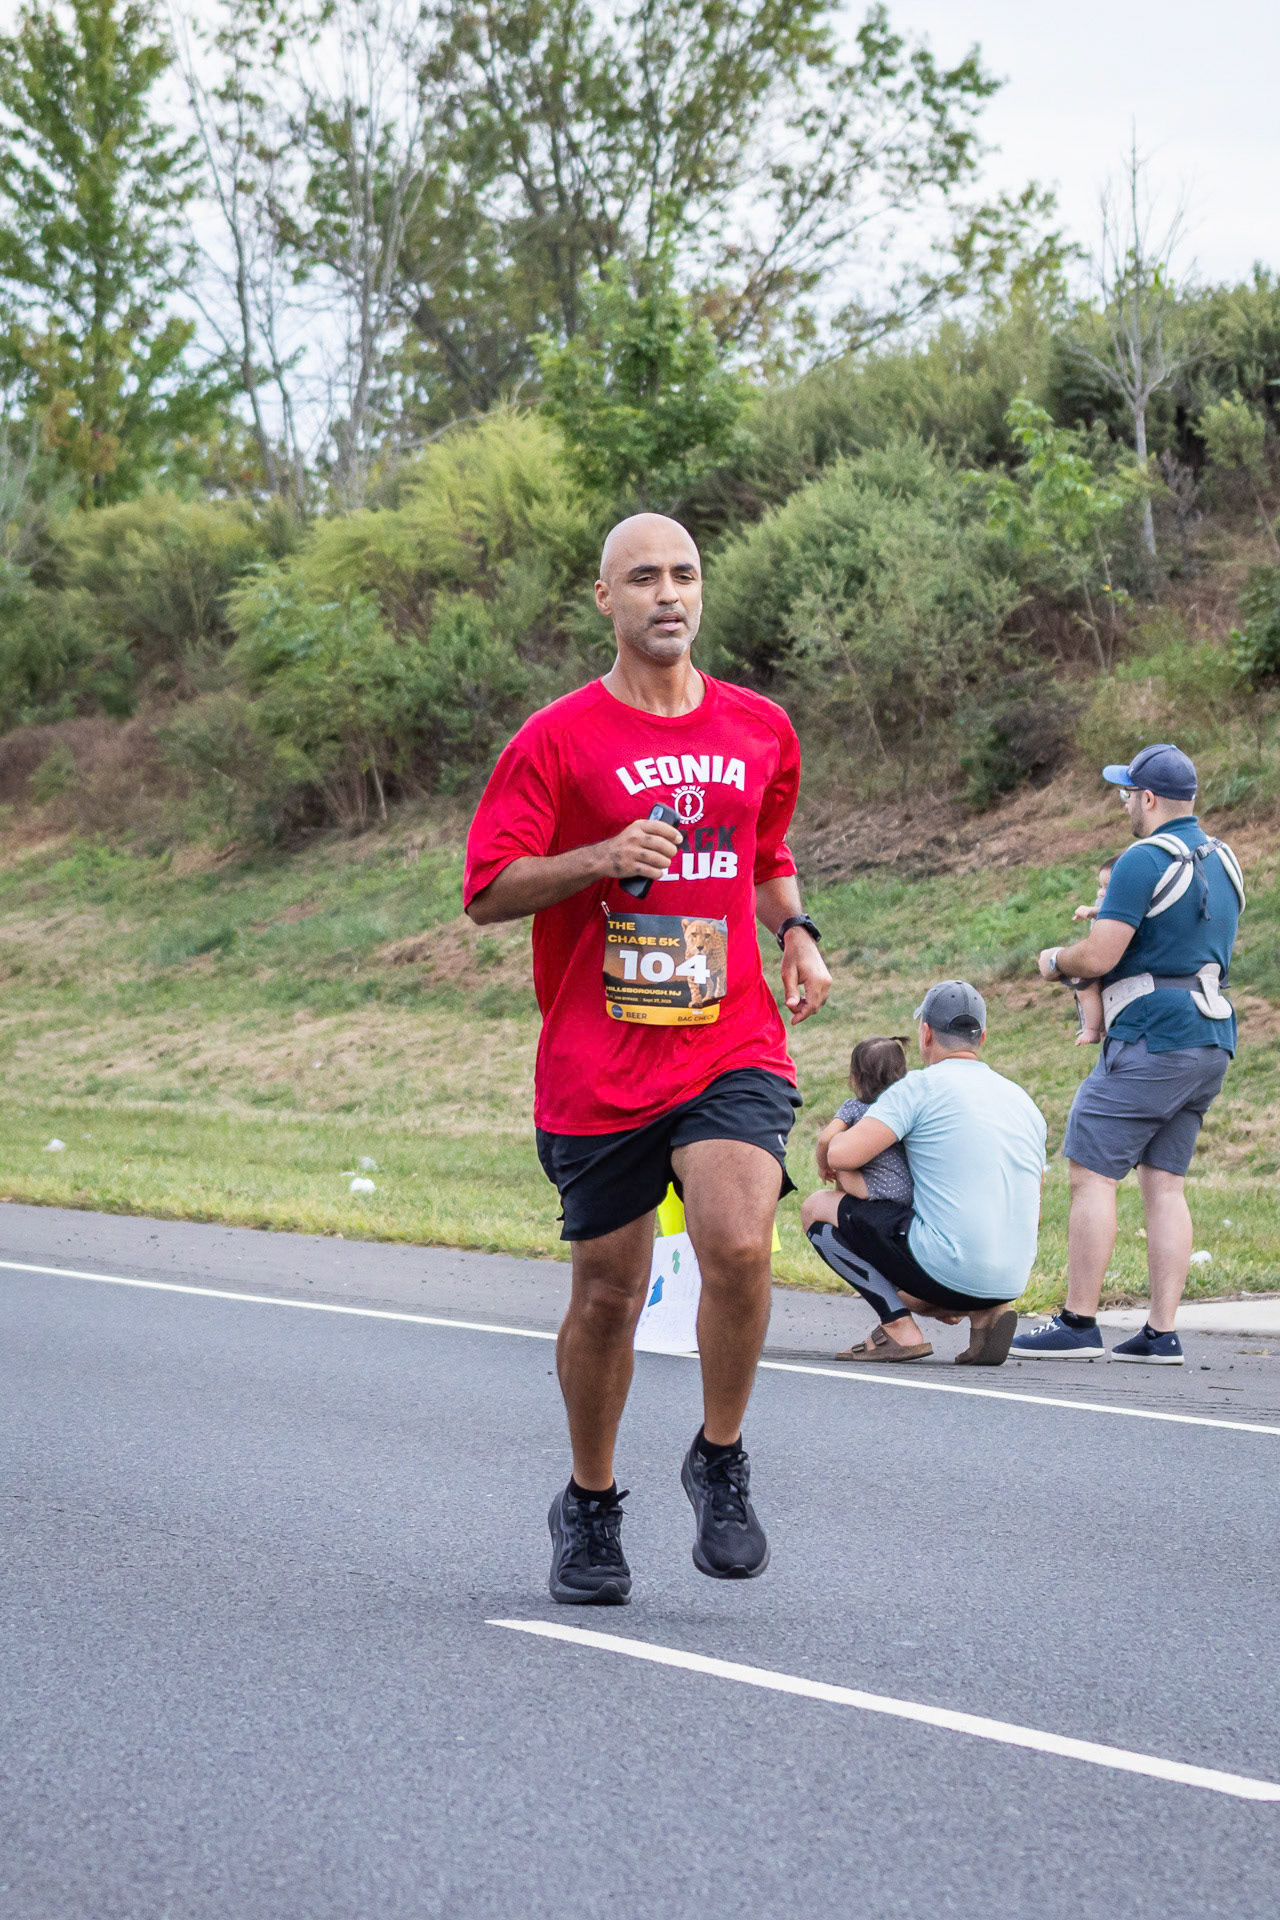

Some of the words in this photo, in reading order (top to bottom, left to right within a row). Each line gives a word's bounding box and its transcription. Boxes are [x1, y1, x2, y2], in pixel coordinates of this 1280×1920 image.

[616, 755, 746, 796] LEONIA
[671, 785, 706, 798] LEONIA
[677, 825, 737, 853] ACK
[658, 850, 738, 881] LUB
[607, 921, 636, 931] THE
[607, 934, 657, 946] CHASE
[658, 937, 681, 947] 5K
[619, 949, 711, 985] 104
[626, 1011, 647, 1019] BEER
